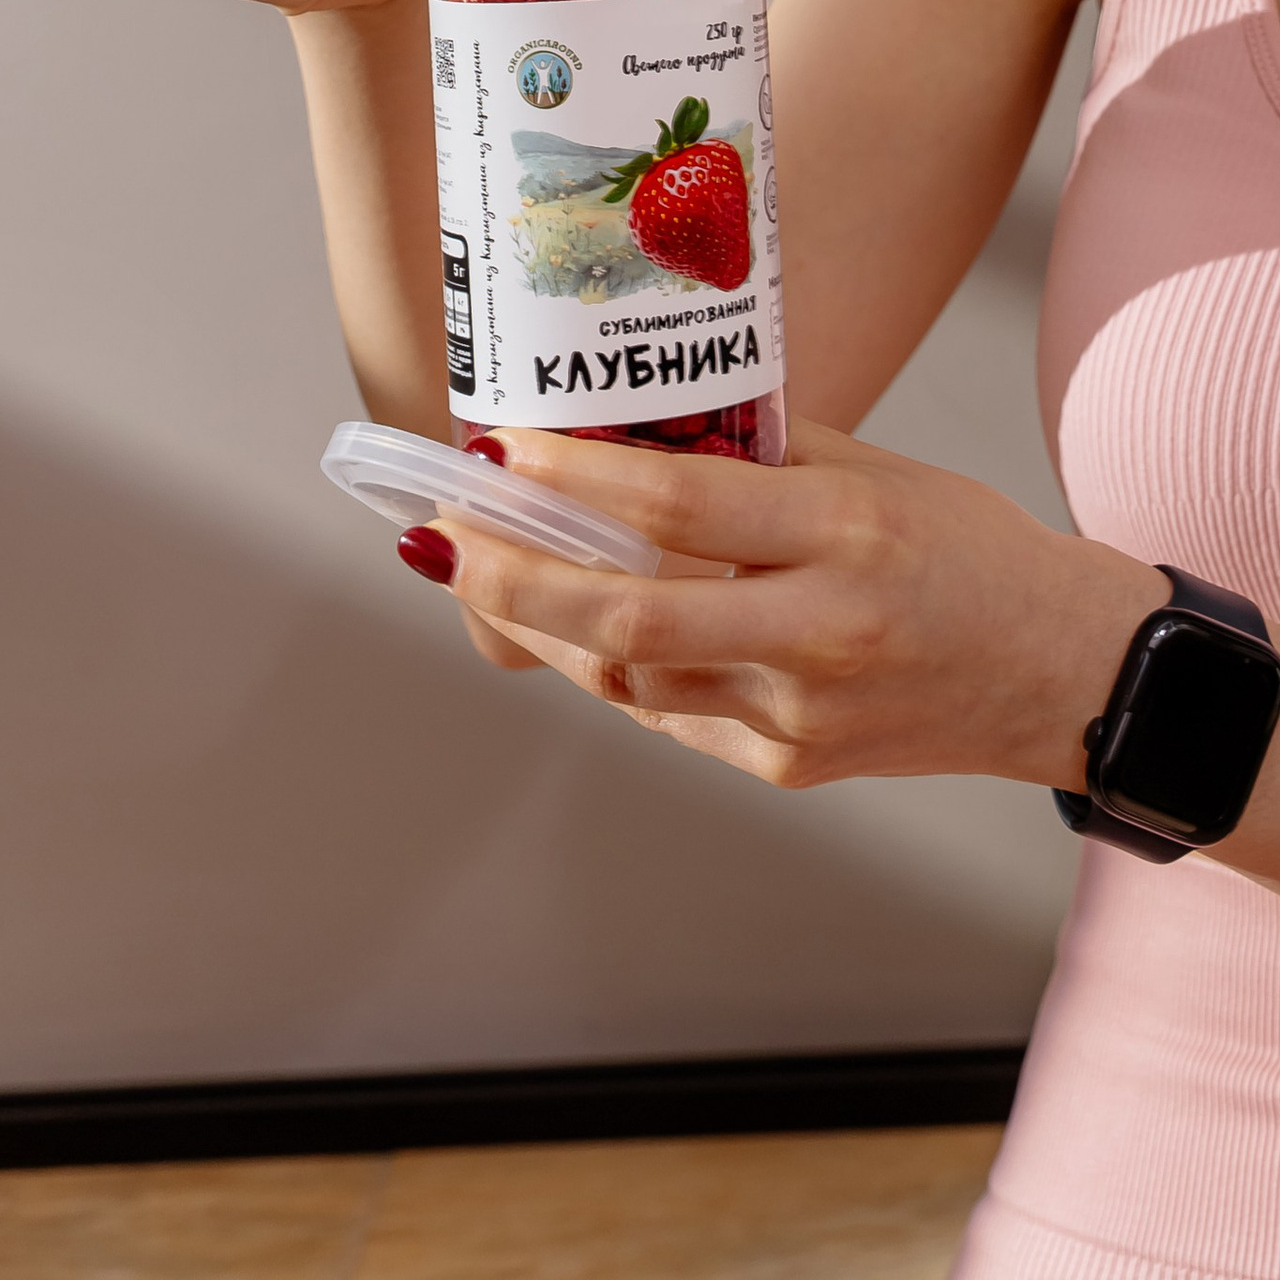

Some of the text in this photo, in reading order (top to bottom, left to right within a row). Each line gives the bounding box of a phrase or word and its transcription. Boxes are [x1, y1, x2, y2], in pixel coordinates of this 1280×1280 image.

[705, 21, 728, 41] 250
[507, 38, 583, 74] ORGANICAROUND
[686, 45, 746, 73] продукта
[479, 139, 493, 159] из
[485, 263, 500, 282] из
[598, 294, 757, 337] СУБЛИМИРОВАННАЯ
[534, 324, 760, 395] КЛУБНИКА
[492, 387, 506, 406] из
